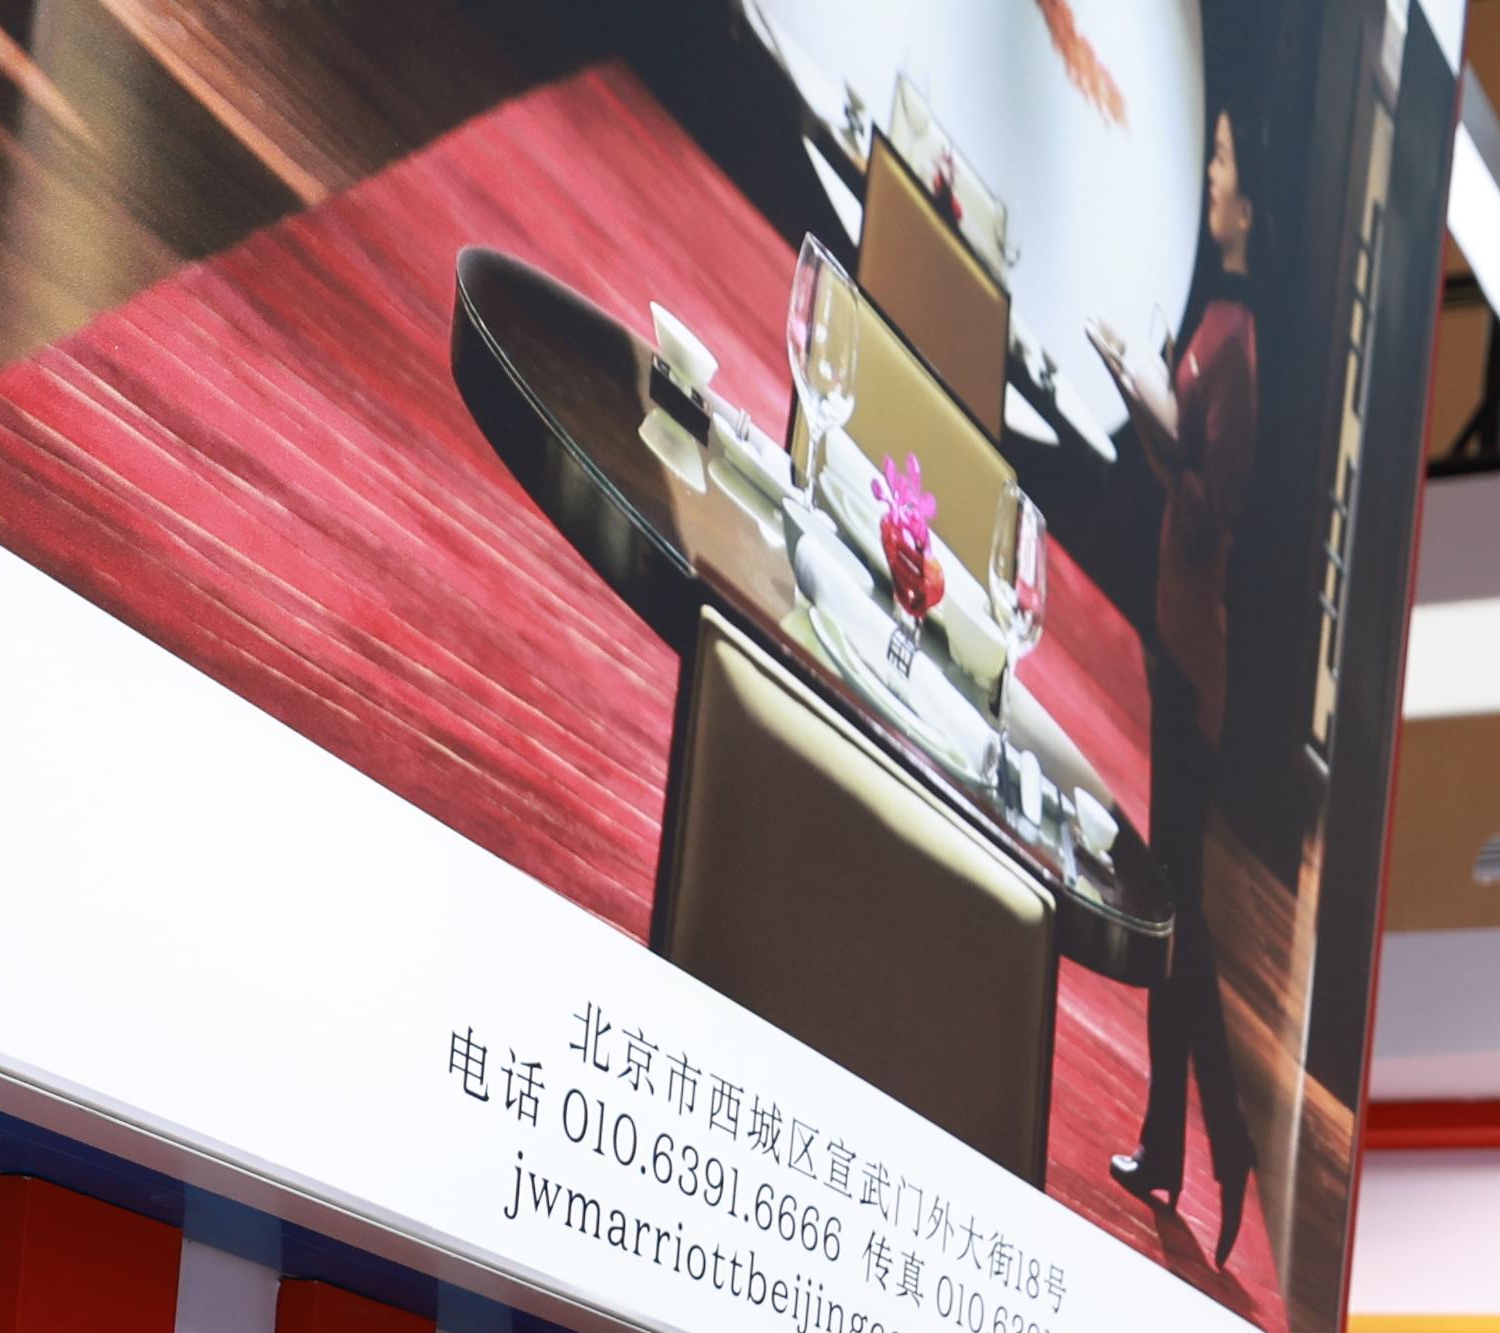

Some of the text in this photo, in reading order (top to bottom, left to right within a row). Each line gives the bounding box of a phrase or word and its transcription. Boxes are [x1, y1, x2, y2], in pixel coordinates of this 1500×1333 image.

[447, 1024, 544, 1127] 电话
[562, 1087, 842, 1264] 010.6391.6666
[861, 1229, 925, 1309] 传真
[569, 1000, 1067, 1316] 北京市西城区宣武门外大街18号
